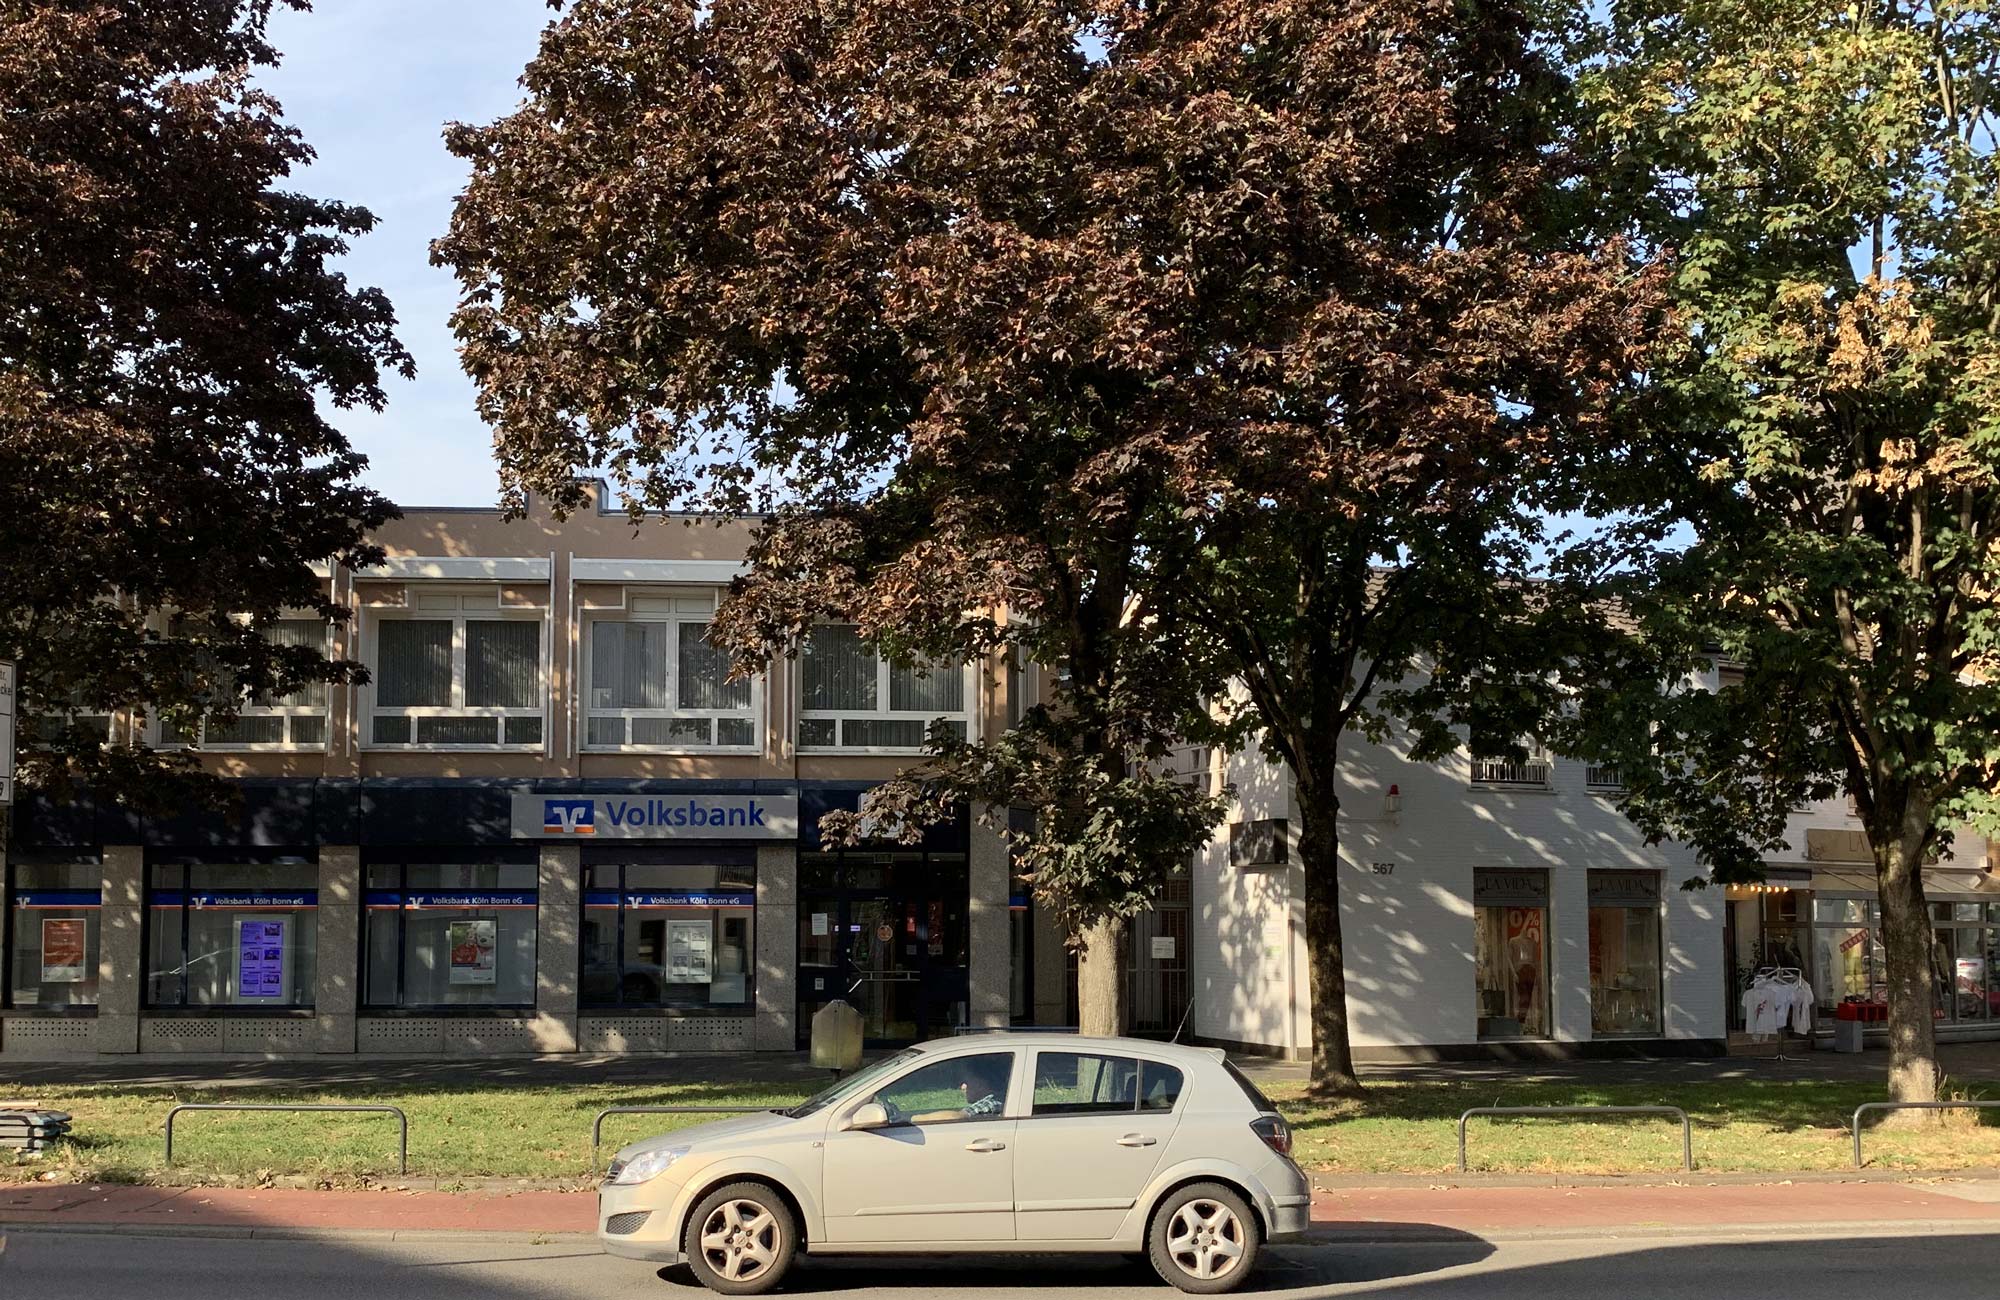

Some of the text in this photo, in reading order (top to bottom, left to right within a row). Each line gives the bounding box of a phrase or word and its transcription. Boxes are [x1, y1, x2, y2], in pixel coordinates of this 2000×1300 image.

[605, 800, 766, 827] Volksbank
[1372, 863, 1395, 875] 567
[214, 897, 304, 905] Volksbank Köln Bonn eG
